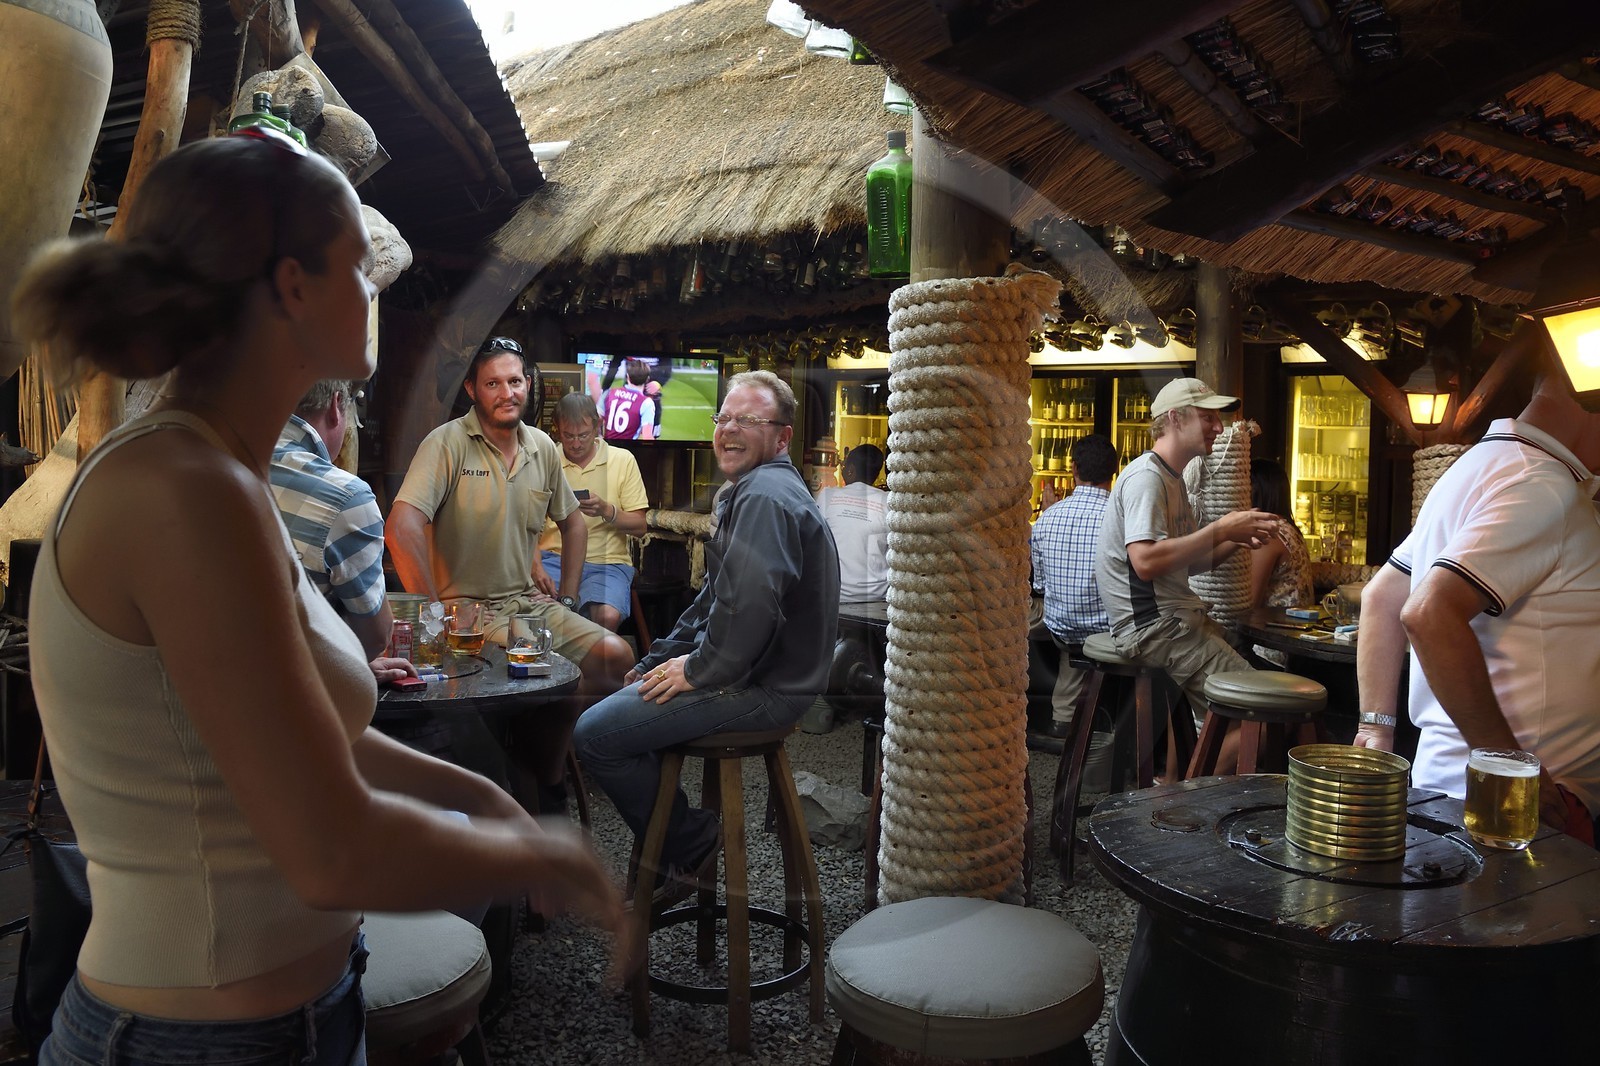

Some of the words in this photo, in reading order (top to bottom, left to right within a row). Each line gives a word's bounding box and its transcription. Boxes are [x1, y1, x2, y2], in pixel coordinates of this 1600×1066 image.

[614, 389, 638, 402] NOBLE
[606, 398, 632, 433] 16
[476, 469, 490, 477] LOFT
